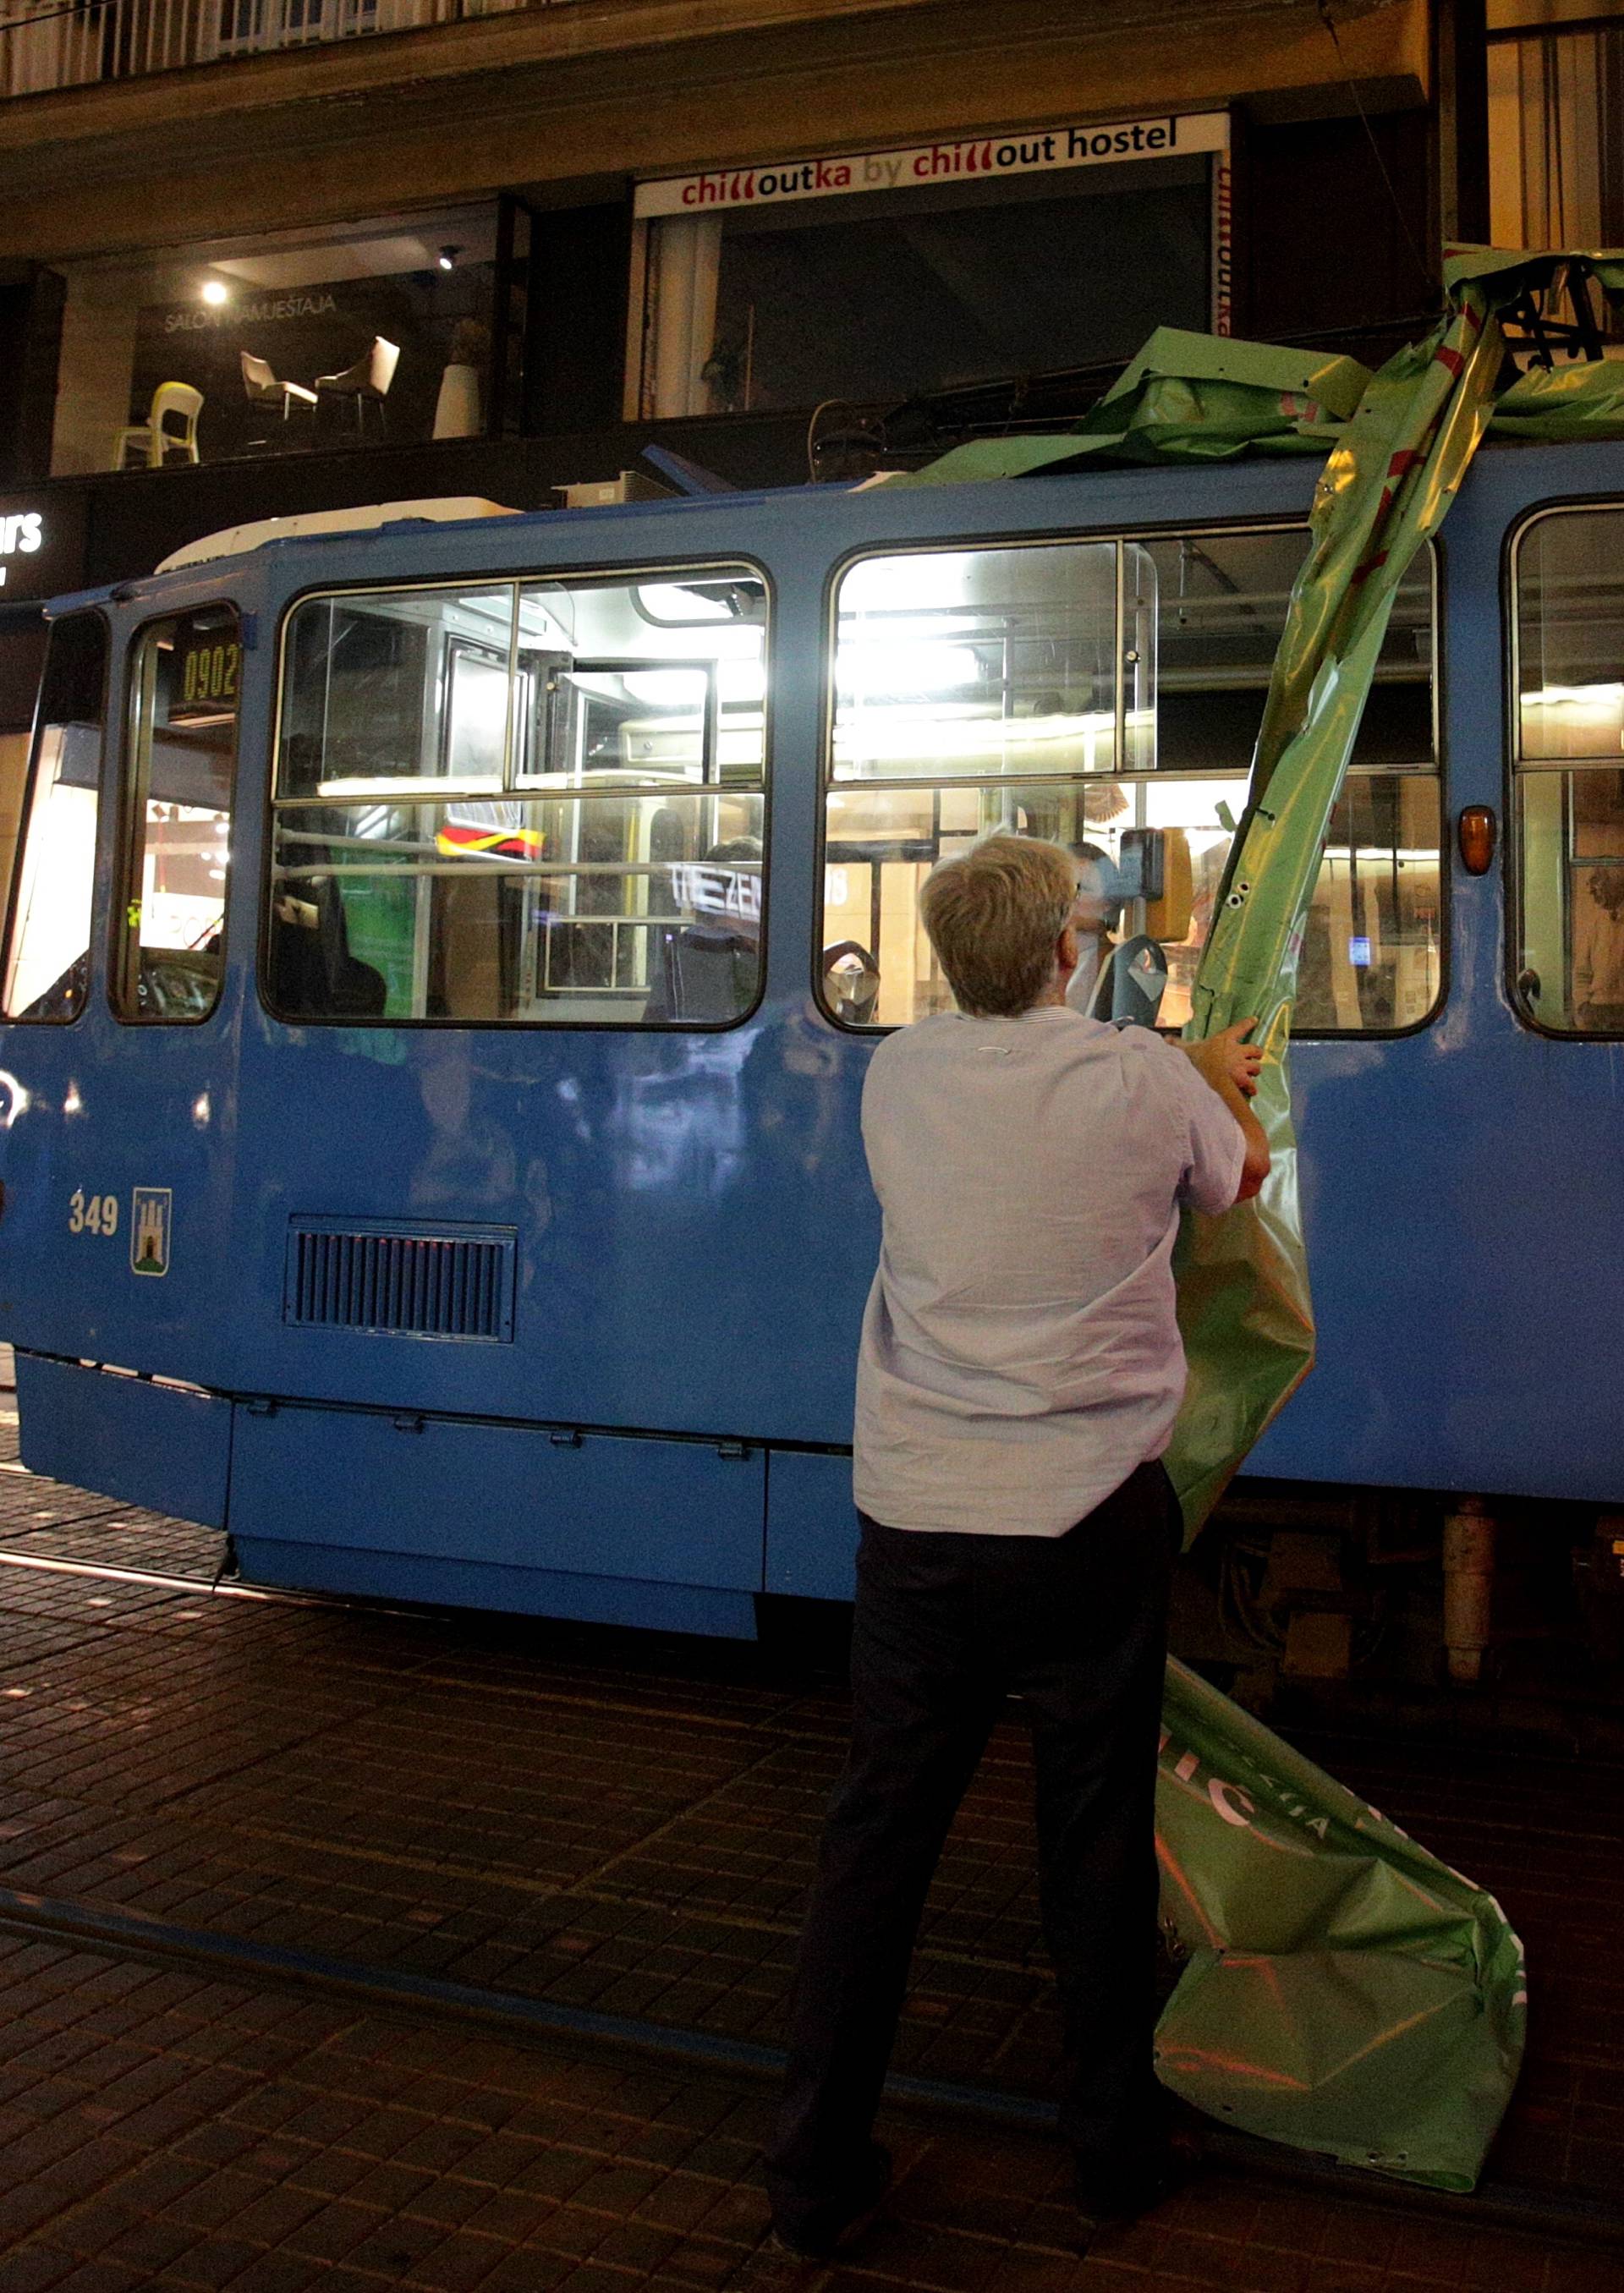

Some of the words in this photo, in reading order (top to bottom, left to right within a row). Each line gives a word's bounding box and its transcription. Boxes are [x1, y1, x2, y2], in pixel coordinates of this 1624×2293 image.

[682, 158, 851, 206] chilloutka
[863, 155, 903, 187] by
[914, 136, 1056, 177] chillout
[1068, 116, 1178, 159] hostel
[0, 512, 42, 554] rs
[184, 644, 239, 700] 0902
[69, 1193, 118, 1236] 349
